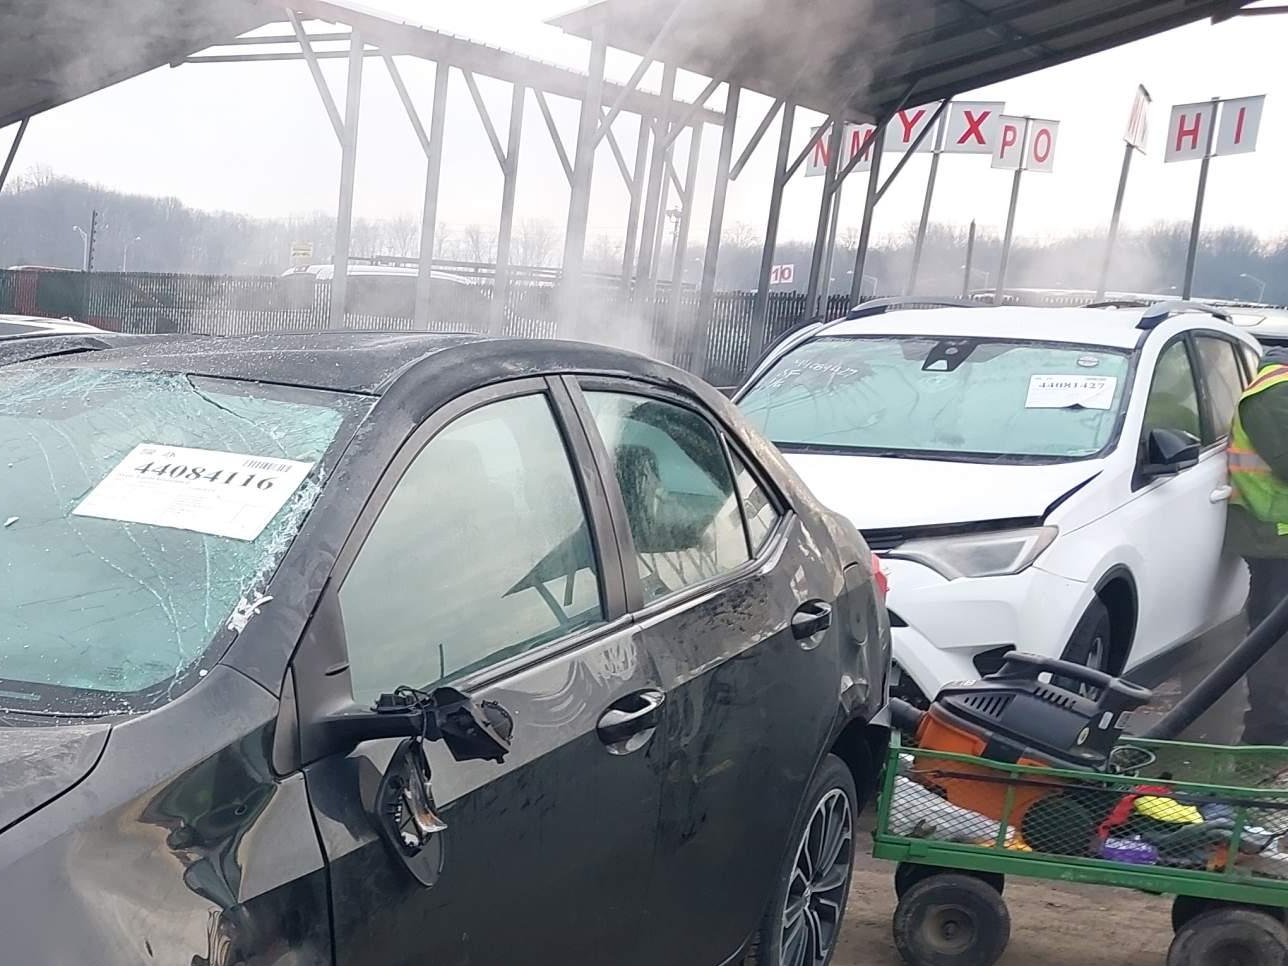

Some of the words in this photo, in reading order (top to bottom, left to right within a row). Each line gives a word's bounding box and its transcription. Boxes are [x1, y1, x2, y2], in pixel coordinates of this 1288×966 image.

[899, 110, 926, 143] Y
[956, 110, 992, 145] X
[999, 125, 1017, 159] P
[1175, 112, 1202, 152] H
[1234, 107, 1246, 144] I
[772, 267, 792, 281] 10
[134, 460, 275, 491] 44084116
